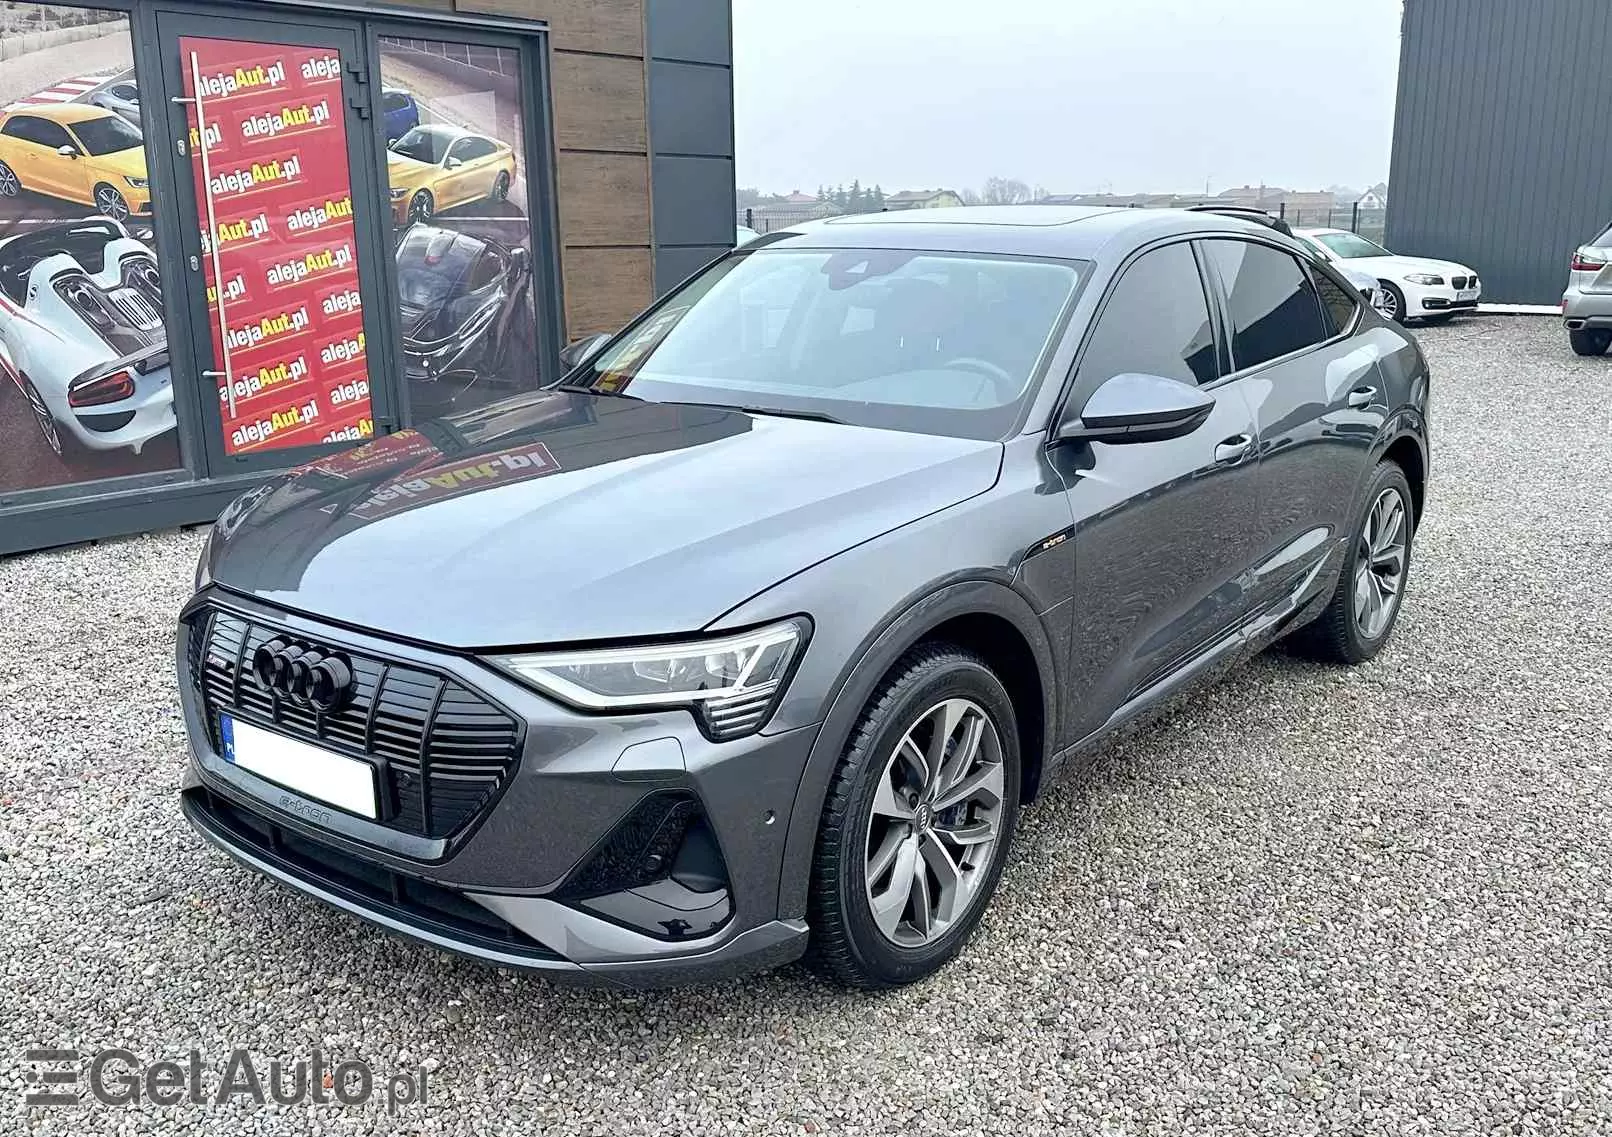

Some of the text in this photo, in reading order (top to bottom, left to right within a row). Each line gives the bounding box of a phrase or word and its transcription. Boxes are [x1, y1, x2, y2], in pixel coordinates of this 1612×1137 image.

[301, 56, 340, 79] aleja
[241, 101, 329, 137] alejaAut.pl
[210, 155, 300, 195] alejaAut.pl
[287, 198, 352, 230] alejaAut
[266, 245, 352, 285] alejaAut.pl
[322, 290, 361, 314] aleja
[219, 357, 308, 400] aejaAut.pl
[231, 400, 319, 446] alejaAut.pl
